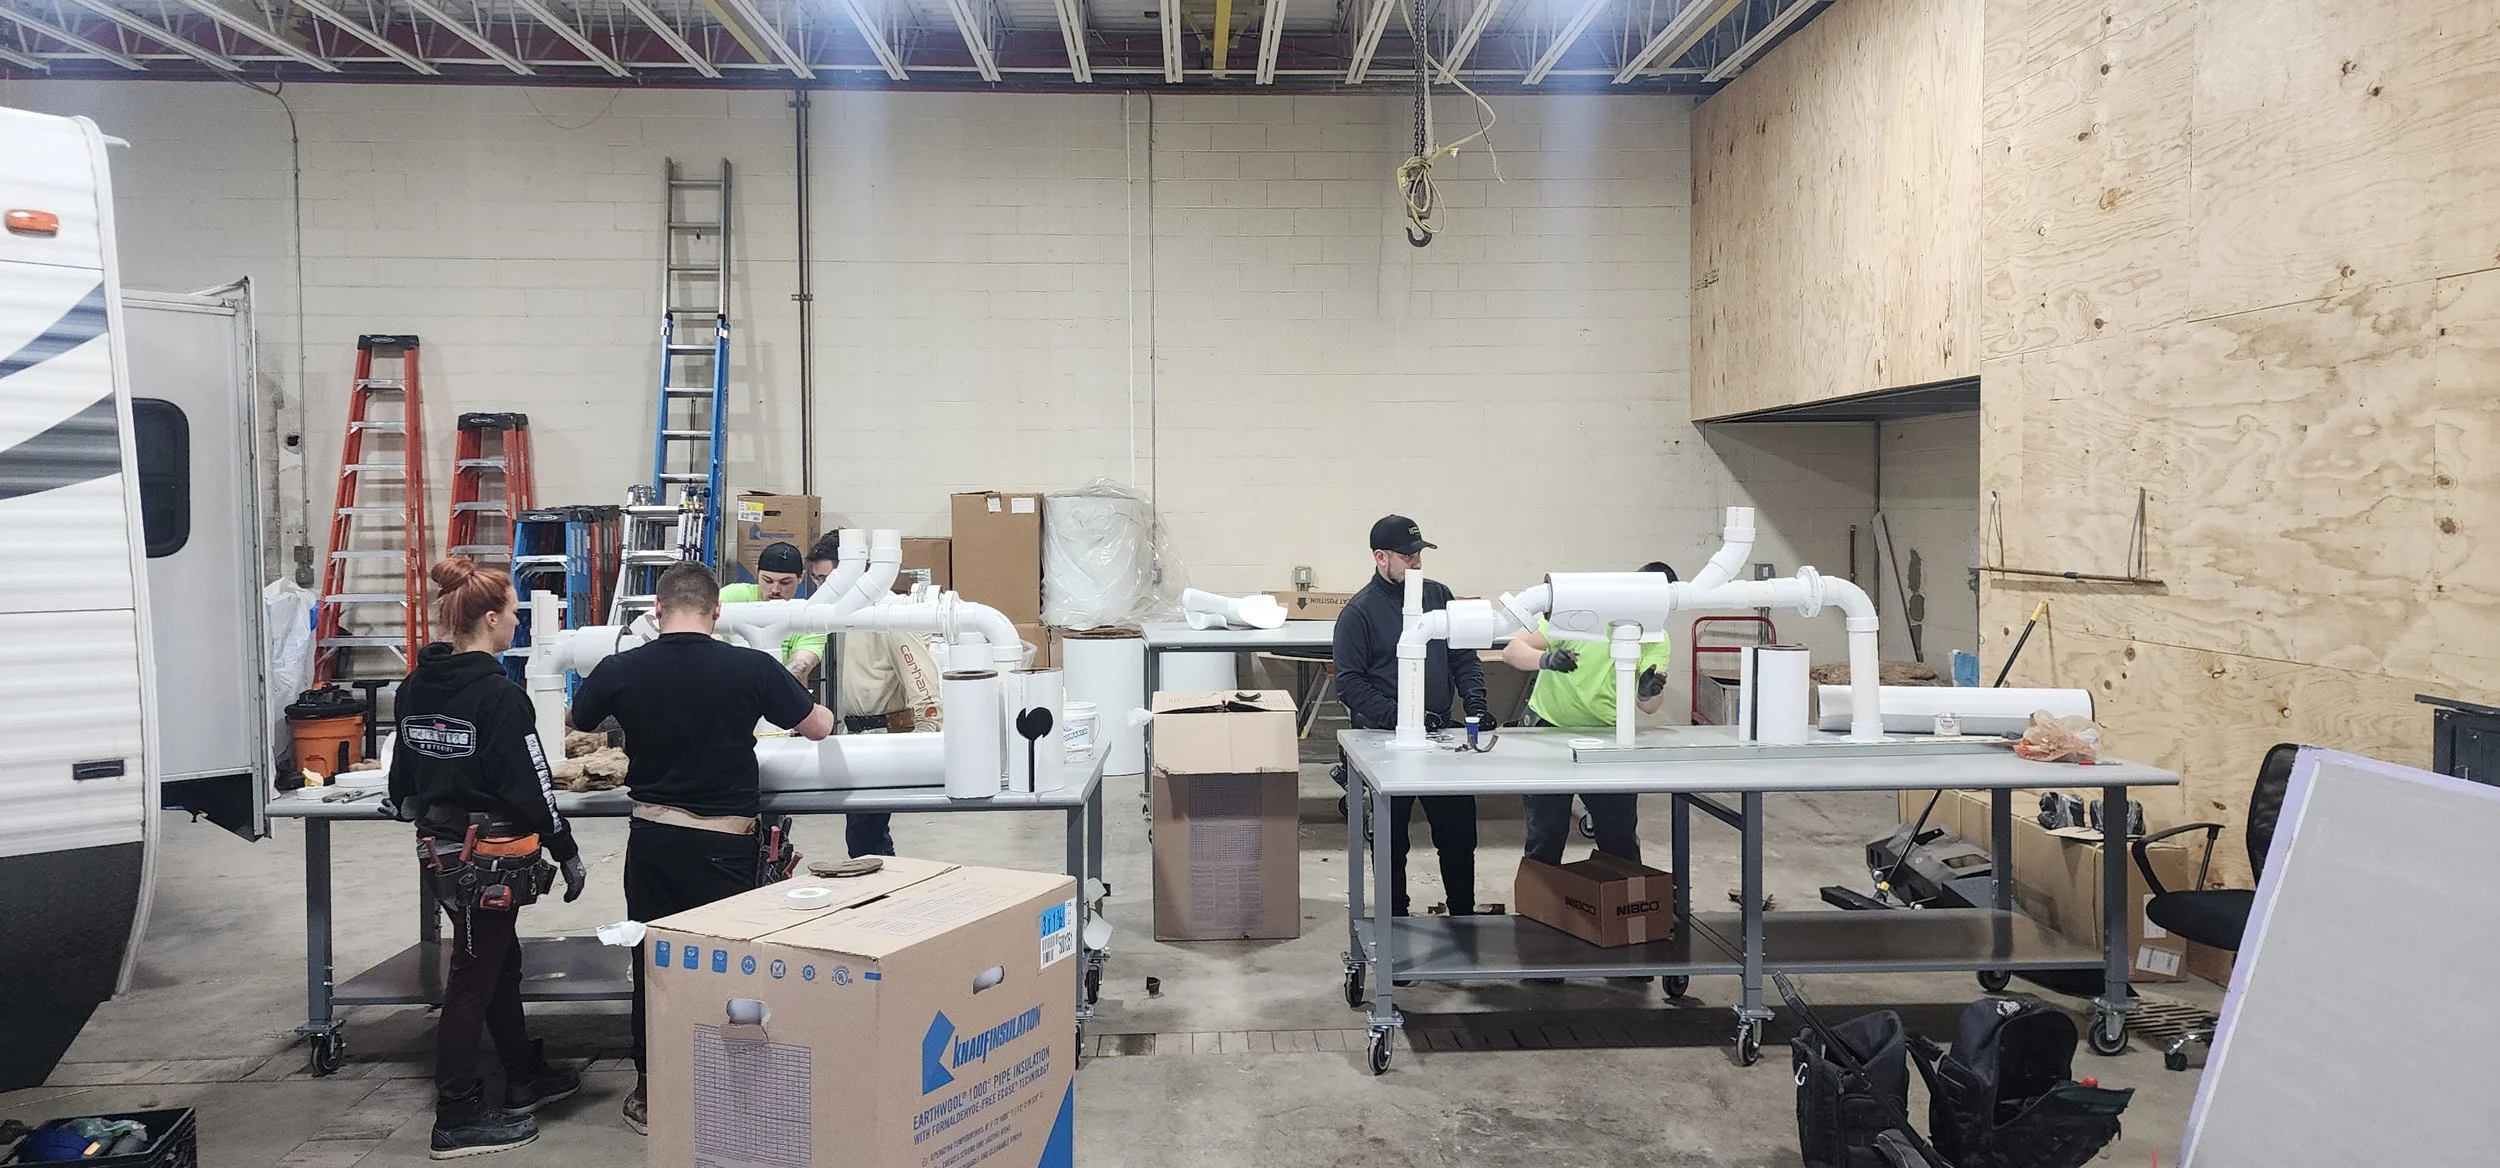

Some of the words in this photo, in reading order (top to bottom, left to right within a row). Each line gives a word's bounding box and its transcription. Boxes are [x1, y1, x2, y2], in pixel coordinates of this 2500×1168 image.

[1564, 895, 1597, 916] NIBCO
[1616, 900, 1660, 917] NIBCO
[993, 1068, 1011, 1089] PIPE
[1013, 1045, 1050, 1078] INSULATION
[914, 1128, 931, 1146] WITH
[1019, 1062, 1050, 1090] TECHNOLOGY
